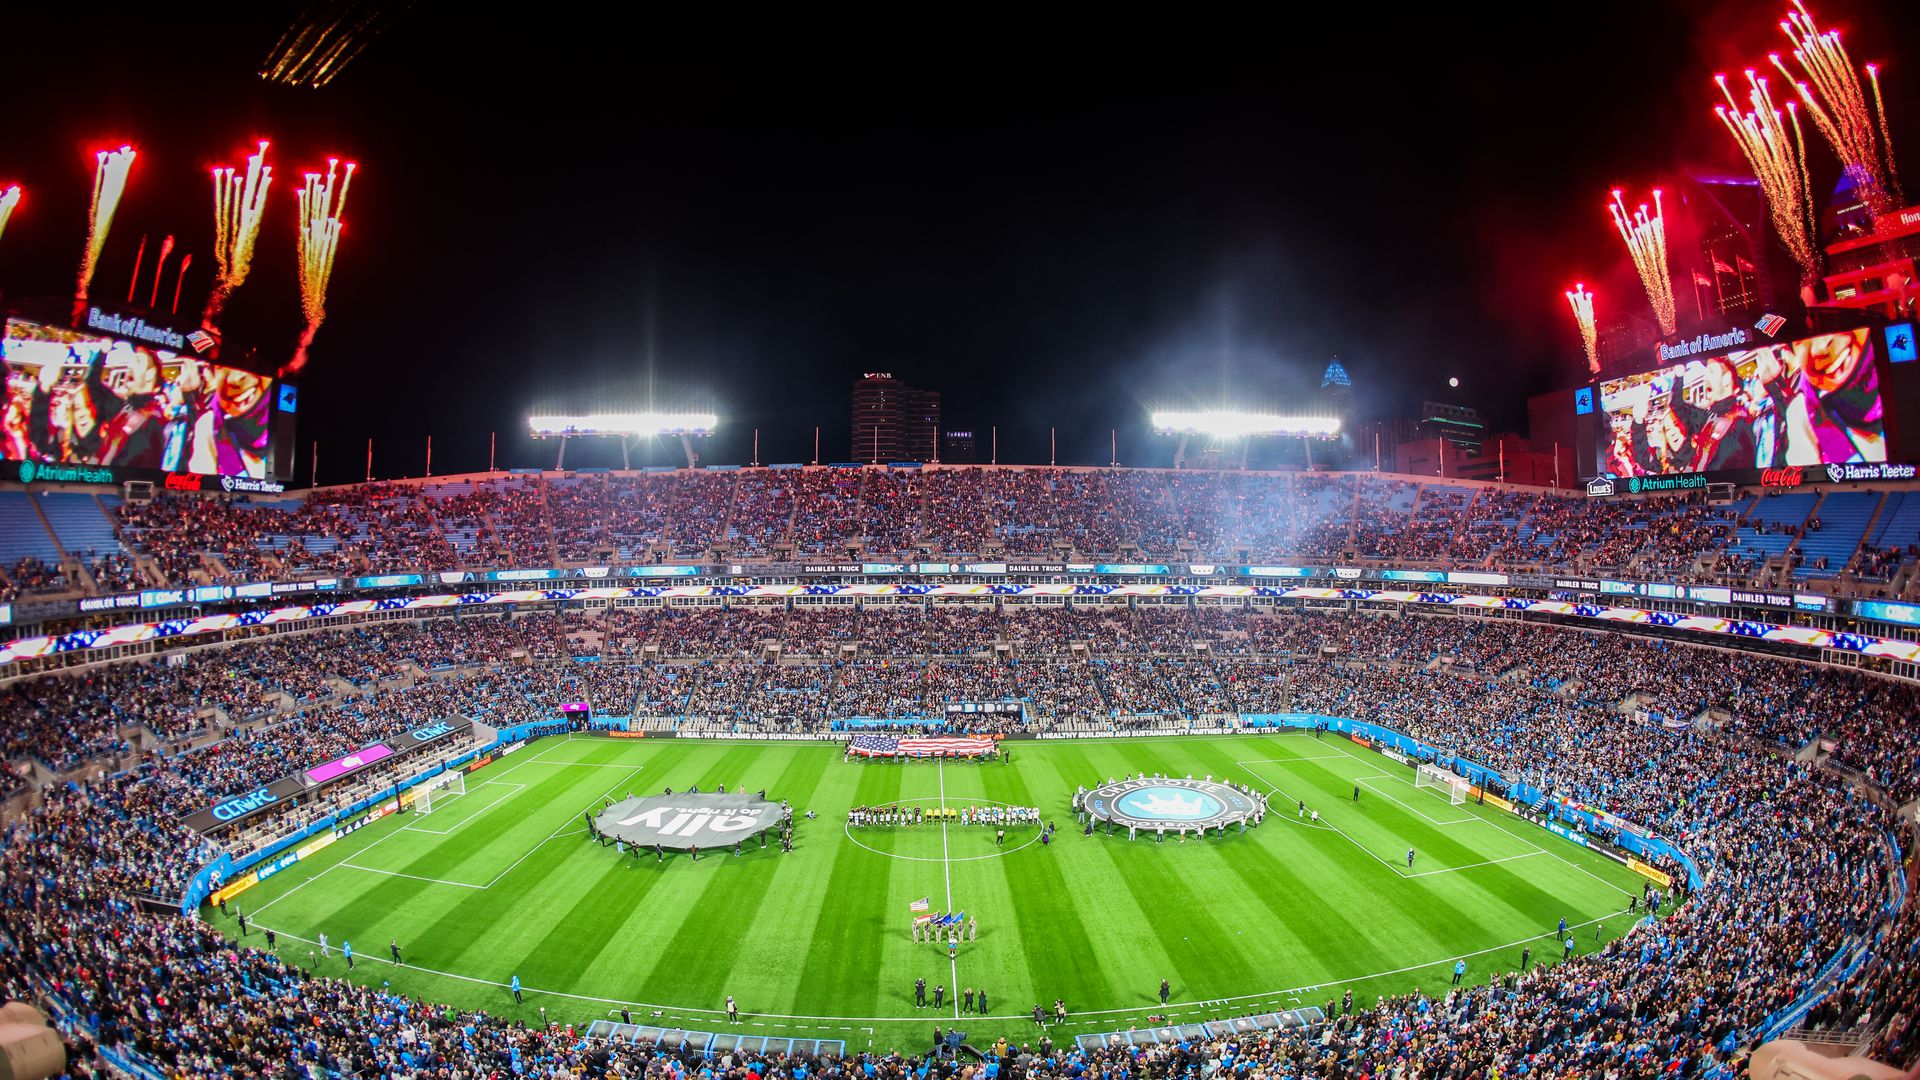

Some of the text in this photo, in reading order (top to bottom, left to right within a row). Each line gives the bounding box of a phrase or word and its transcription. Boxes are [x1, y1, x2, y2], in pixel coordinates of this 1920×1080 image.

[88, 307, 184, 349] Bank of America
[1660, 340, 1690, 361] Bank
[1690, 335, 1702, 354] of
[36, 464, 113, 483] Atrium Health
[1845, 463, 1916, 479] Harris Teeter
[235, 478, 285, 493] Harris Teeter
[1642, 474, 1707, 491] Atrium Health
[805, 565, 860, 573] DAIMLER TRUCK
[1009, 565, 1039, 573] DAIMLER
[1041, 565, 1063, 573] TRUCK
[1556, 580, 1599, 590] DAIMLER TRUCK
[1732, 591, 1791, 606] DAIMLER TRUCK
[609, 730, 644, 738] Honeywell
[716, 732, 751, 740] BUILDING
[752, 732, 767, 740] AND
[768, 732, 829, 741] SUSTAINABILITY
[1043, 732, 1078, 740] HEALTHY
[1078, 731, 1114, 739] BUILDING
[1115, 730, 1131, 738] AND
[1131, 728, 1188, 737] SUSTAINABILITY
[1190, 728, 1223, 736] PARTNER
[1098, 779, 1220, 798] CHARLOTTE
[724, 808, 735, 817] it
[741, 808, 762, 817] do
[616, 806, 758, 837] ally
